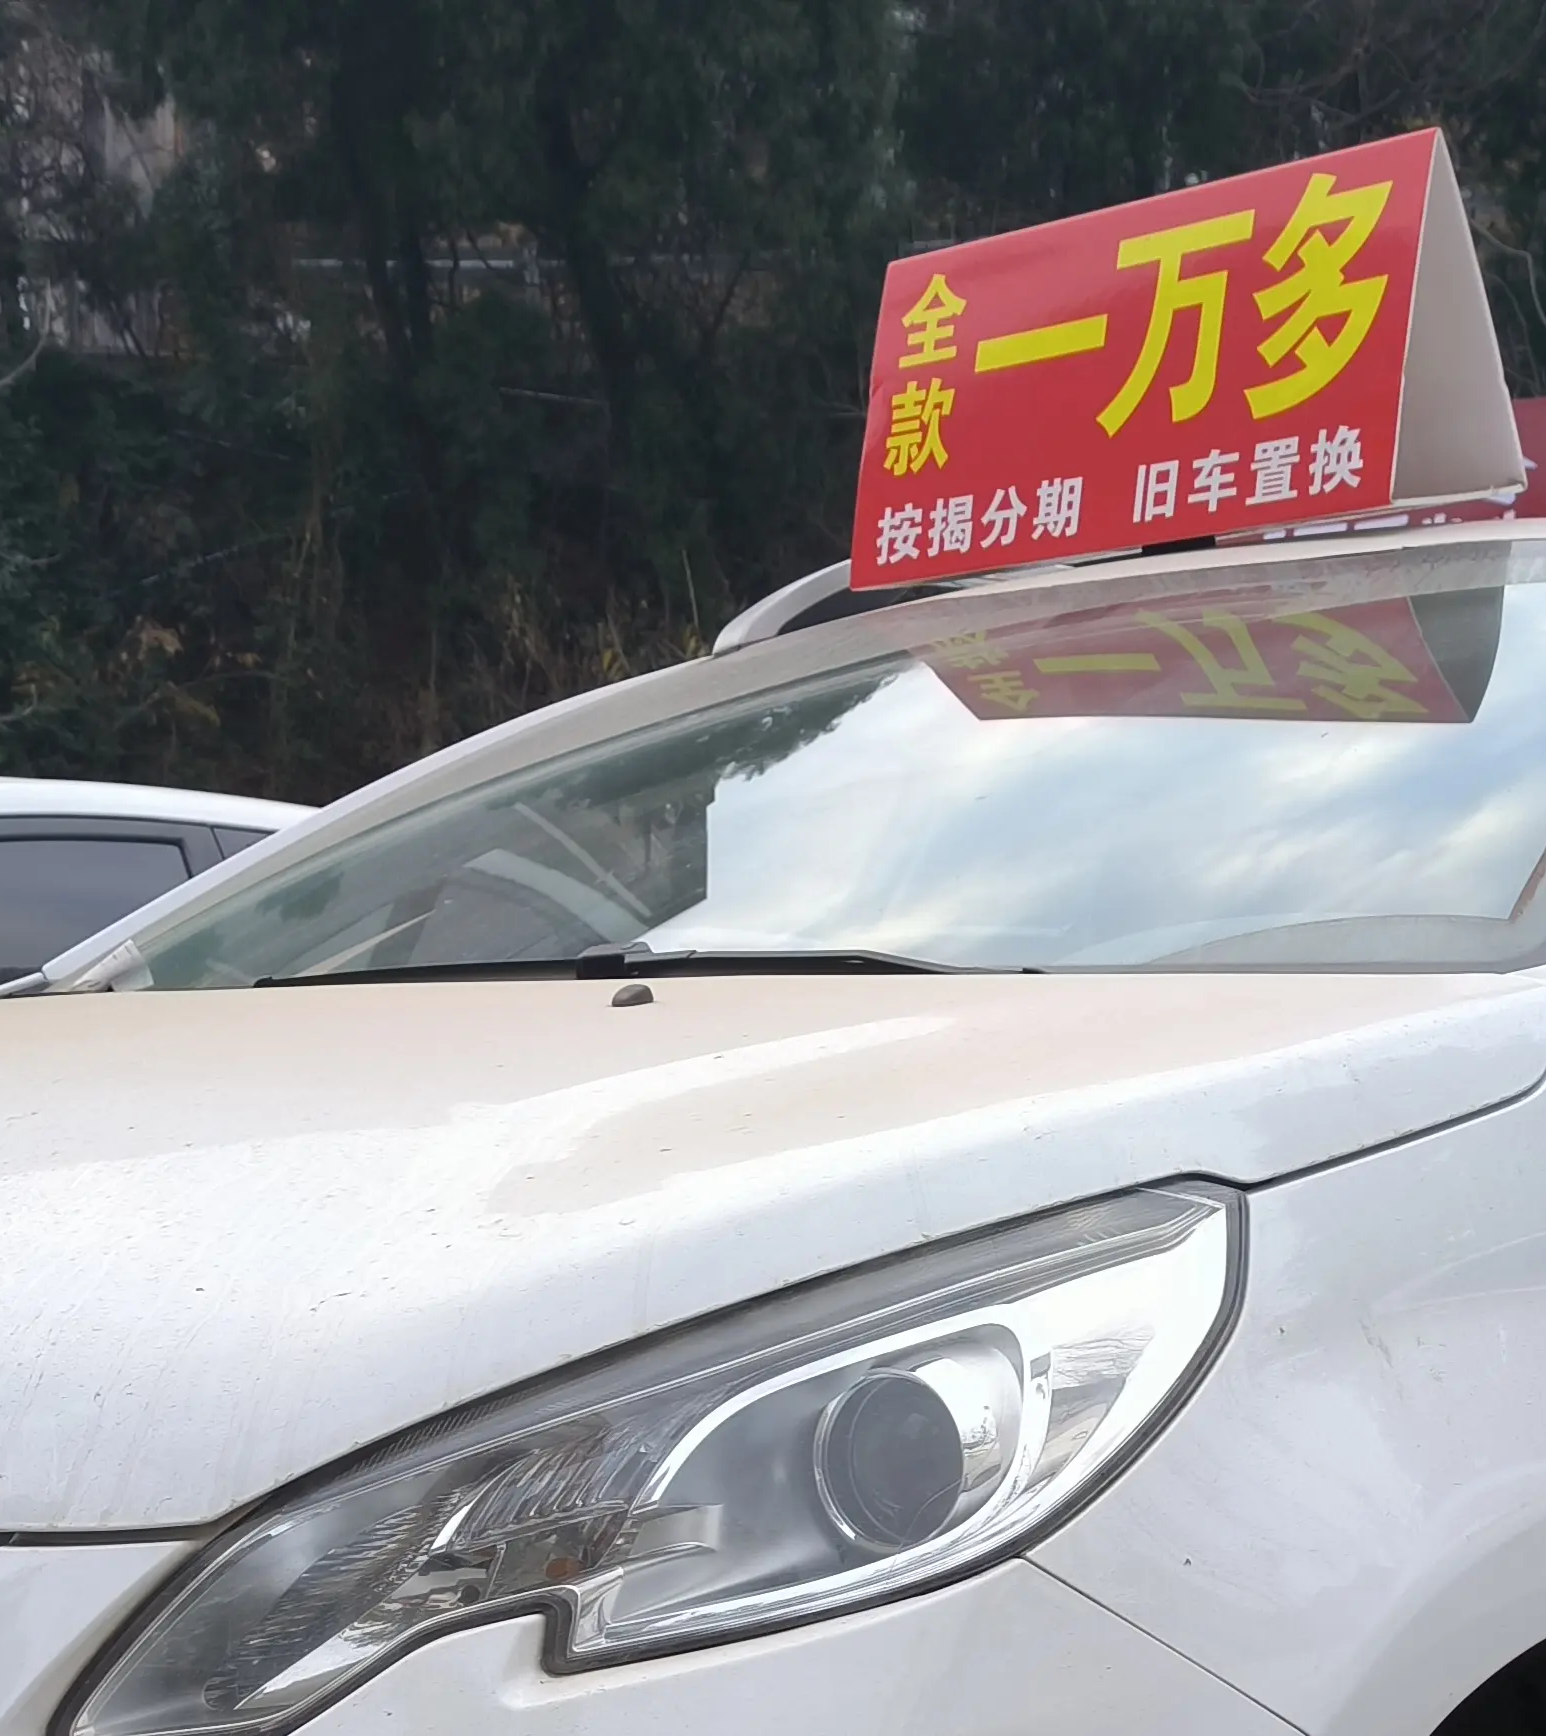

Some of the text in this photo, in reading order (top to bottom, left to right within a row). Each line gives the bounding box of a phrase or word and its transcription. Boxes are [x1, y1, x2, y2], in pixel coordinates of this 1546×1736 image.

[884, 274, 968, 477] 全款
[974, 173, 1394, 438] 一万多
[875, 424, 1365, 567] 按揭分期 旧车置换
